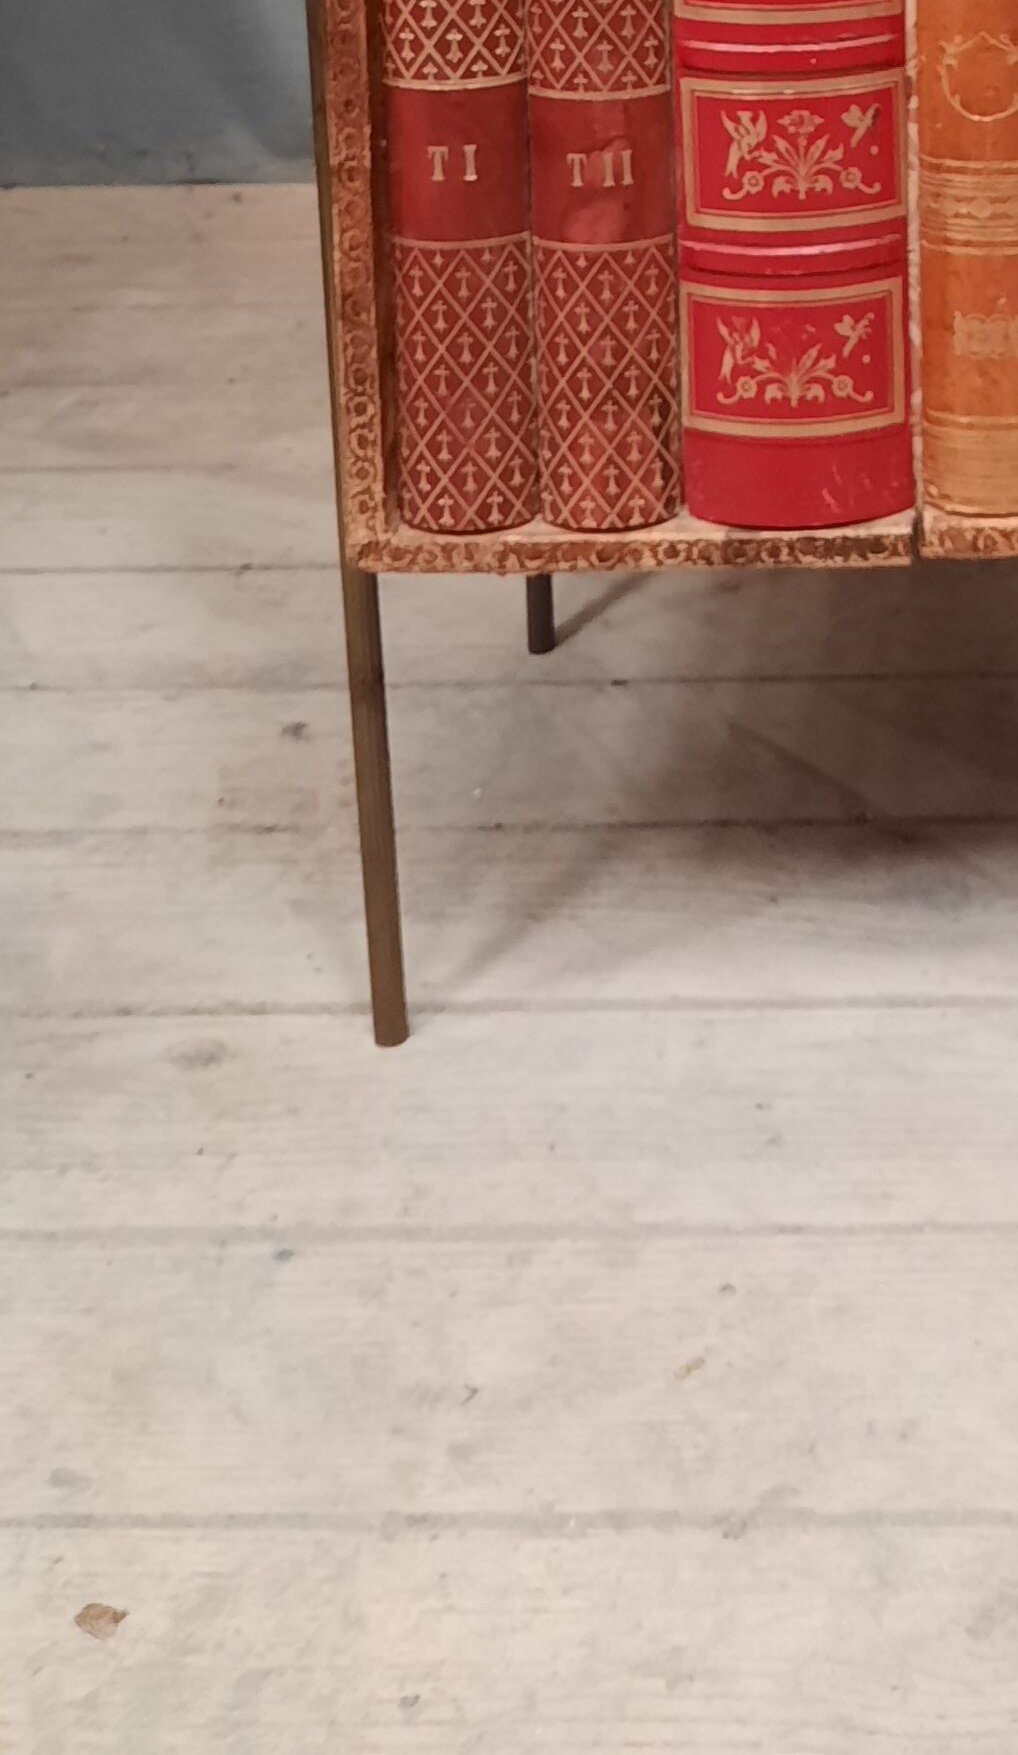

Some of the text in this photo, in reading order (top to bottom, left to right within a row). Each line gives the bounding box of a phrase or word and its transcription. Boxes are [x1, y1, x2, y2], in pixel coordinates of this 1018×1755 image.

[427, 144, 479, 182] T I
[566, 149, 635, 188] T II
